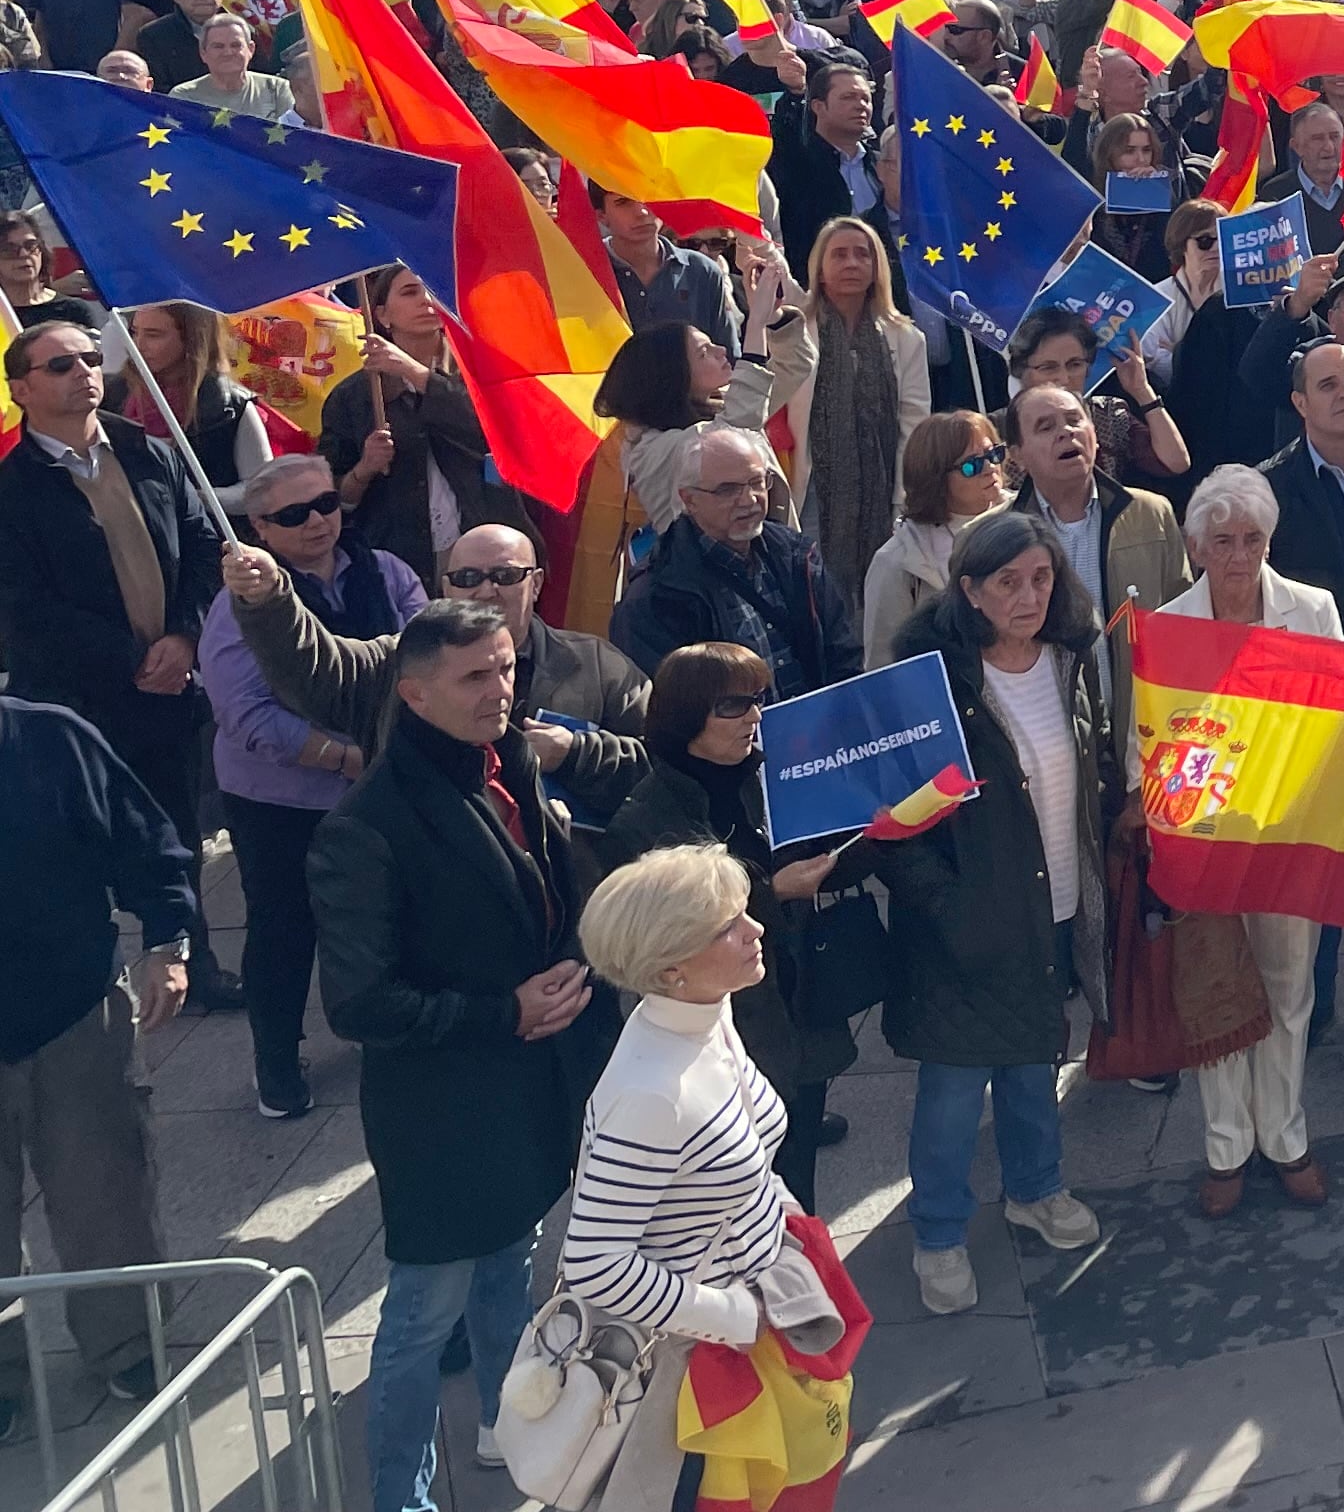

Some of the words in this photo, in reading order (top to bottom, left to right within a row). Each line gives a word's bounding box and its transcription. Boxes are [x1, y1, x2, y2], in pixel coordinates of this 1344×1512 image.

[1231, 216, 1293, 251] ESPAÑA
[1234, 249, 1264, 268] EN
[778, 718, 943, 782] #ESPAÑANOSERINDE
